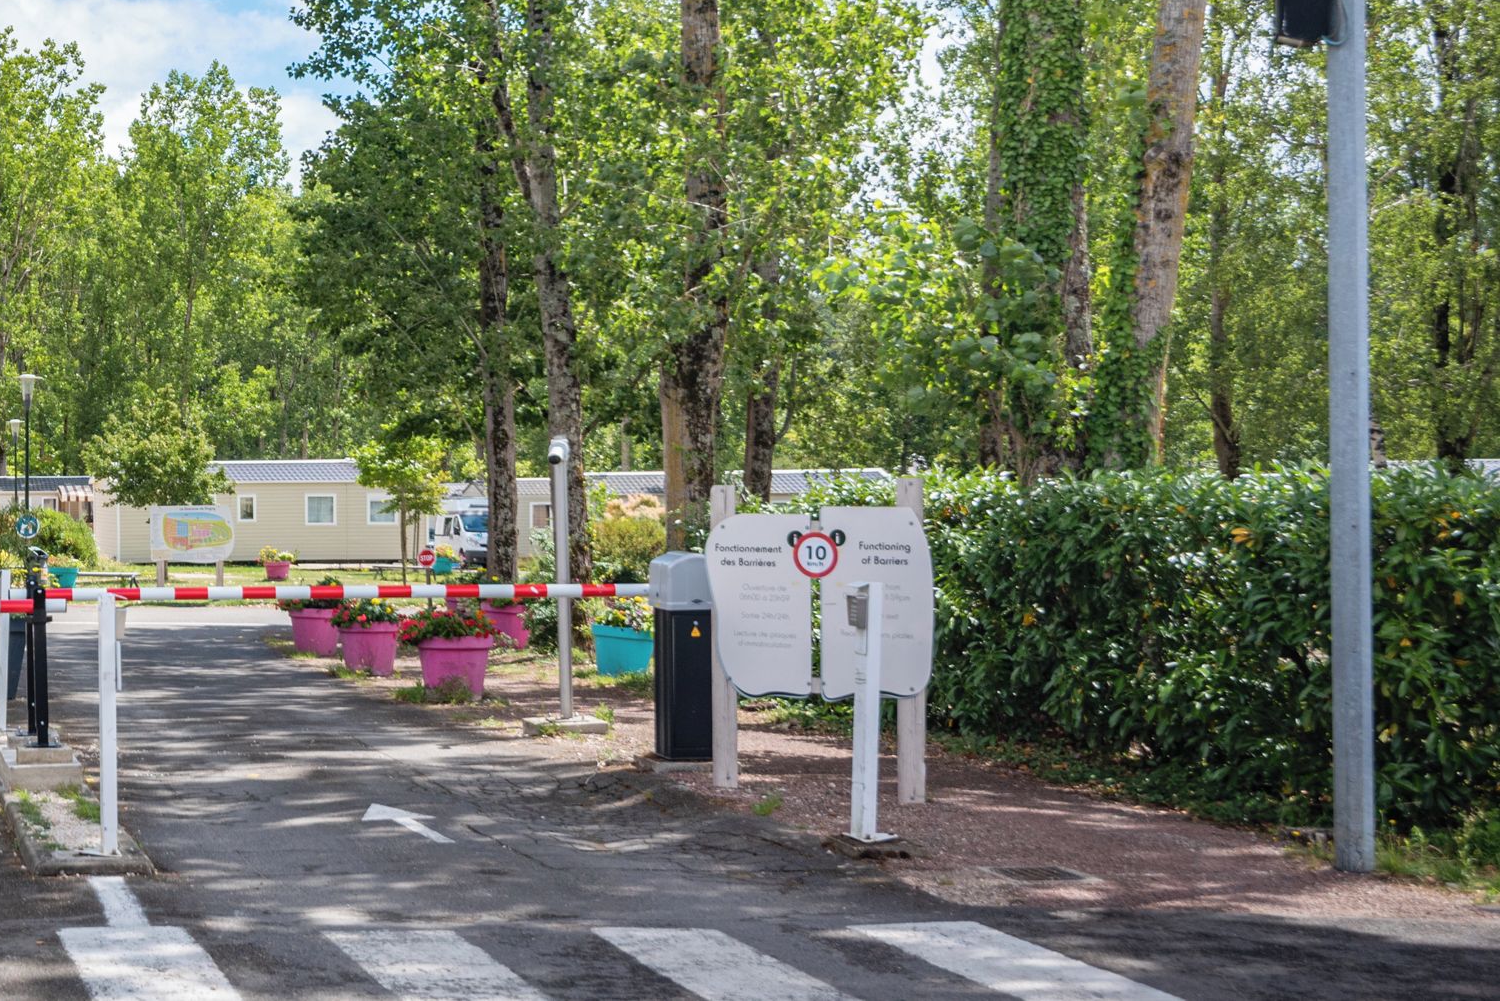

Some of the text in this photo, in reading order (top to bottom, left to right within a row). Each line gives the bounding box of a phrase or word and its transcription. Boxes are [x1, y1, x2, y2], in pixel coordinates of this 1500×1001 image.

[715, 543, 782, 553] Fonctionnement
[858, 541, 911, 554] Functioning
[805, 545, 826, 560] 10
[420, 554, 433, 562] STOP
[720, 558, 777, 567] des Barrières
[861, 556, 909, 565] of Barriers
